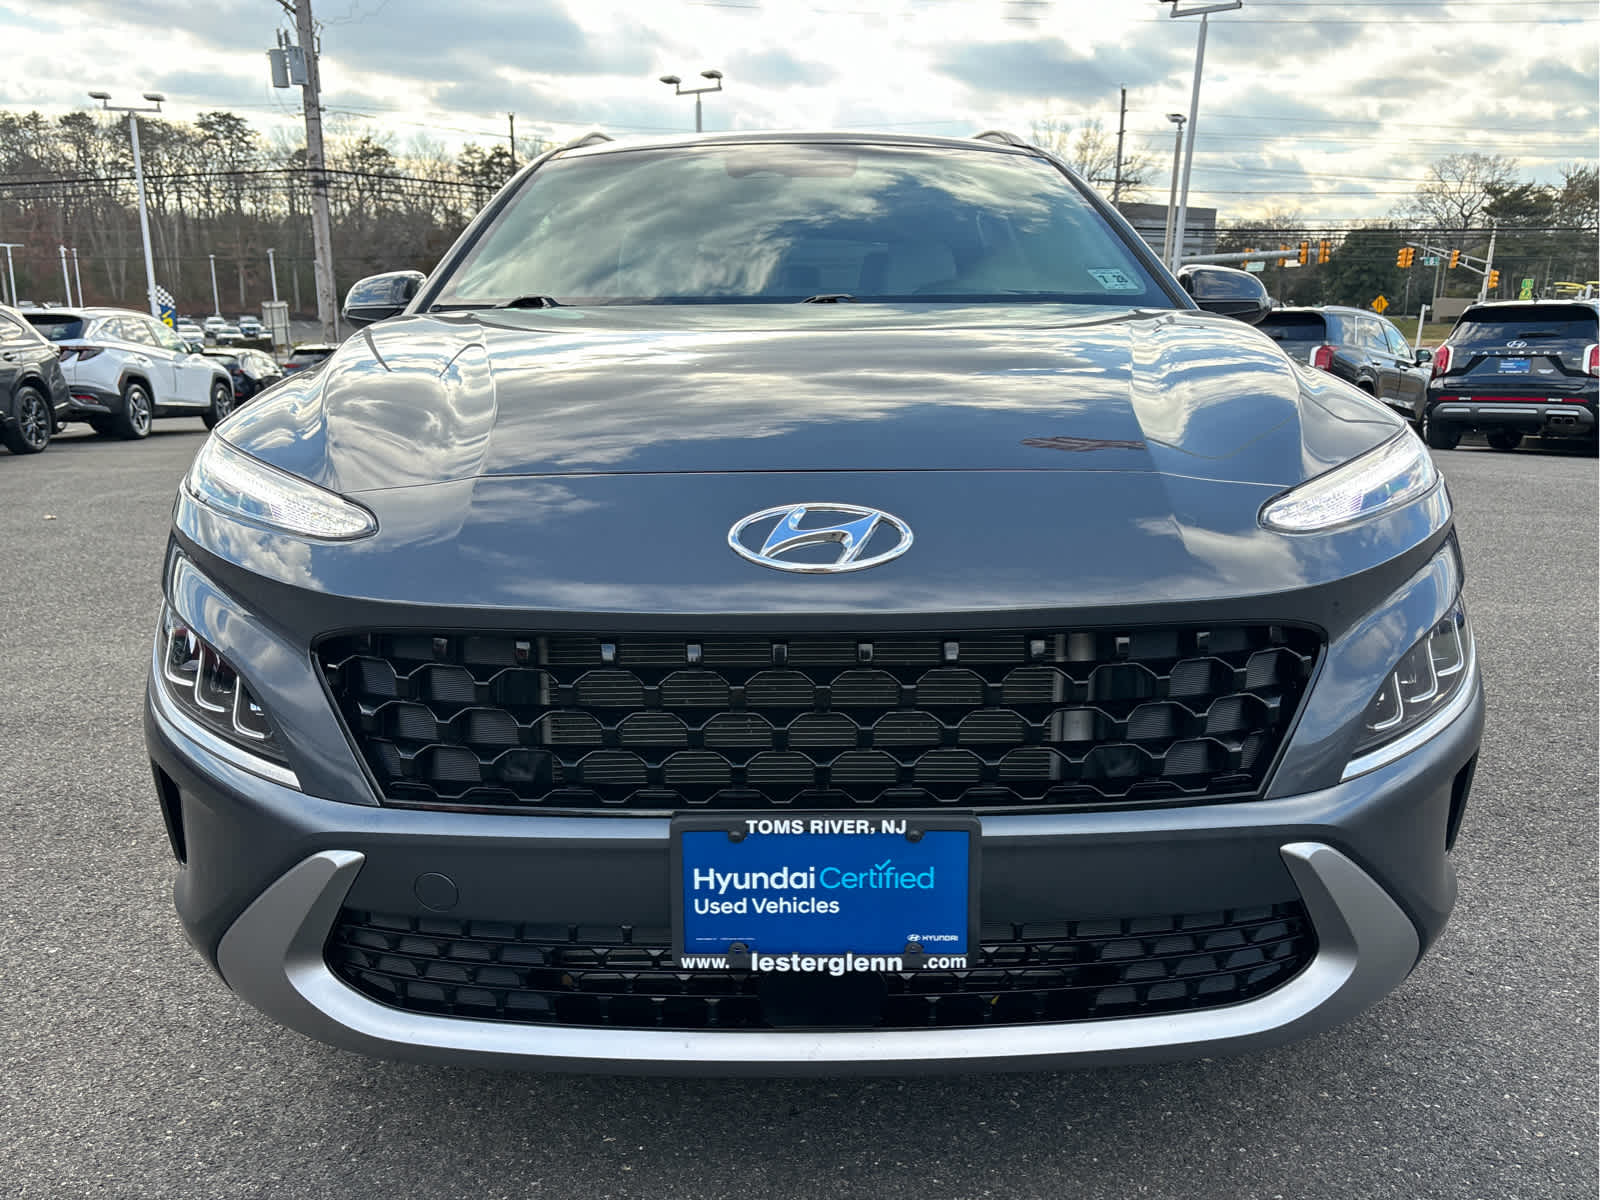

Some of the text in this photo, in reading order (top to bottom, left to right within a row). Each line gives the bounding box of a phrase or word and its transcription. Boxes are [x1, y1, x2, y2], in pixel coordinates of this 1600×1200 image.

[745, 820, 907, 835] TOMS RIVER, NJ
[693, 860, 935, 894] Hyundai Certified
[694, 897, 841, 914] Used Vehicles
[681, 953, 967, 976] www. lesterglenn .com
